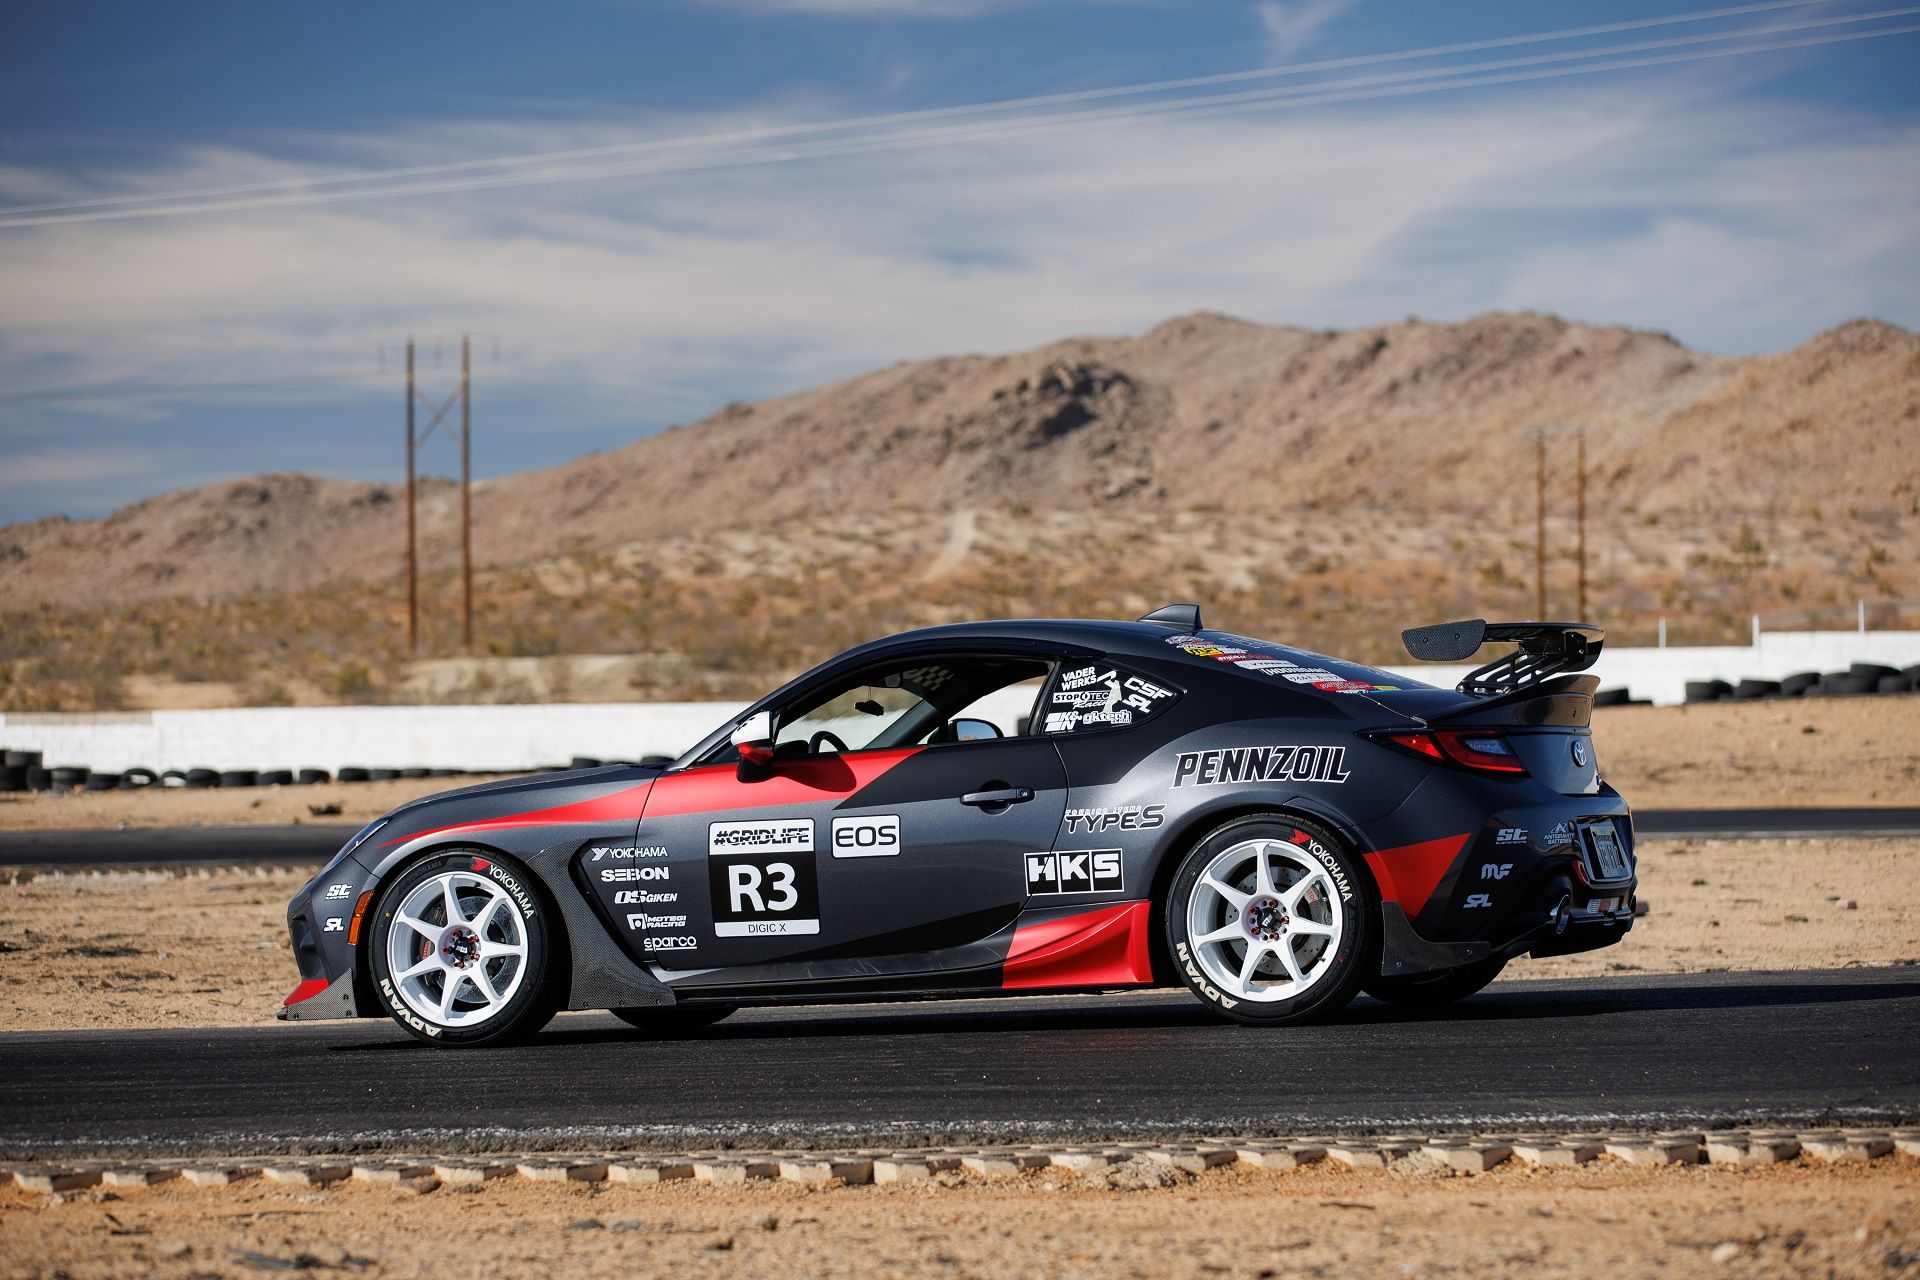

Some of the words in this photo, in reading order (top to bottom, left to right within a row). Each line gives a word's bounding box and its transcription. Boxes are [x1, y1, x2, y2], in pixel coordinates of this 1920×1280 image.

[1062, 666, 1096, 682] VADER
[1061, 675, 1097, 691] WERKS
[1124, 677, 1173, 699] CSF
[1055, 692, 1110, 702] STOPTEC
[1170, 745, 1352, 789] PENNZOIL
[713, 827, 810, 846] #GRIDLIFE
[835, 825, 897, 847] EOS
[608, 846, 668, 859] YOKOHAMA
[600, 866, 670, 882] SEBON
[1028, 852, 1121, 883] HKS
[1307, 838, 1354, 902] YOKOHAMA
[488, 864, 535, 920] YOKOHAMA
[728, 862, 799, 913] R3
[645, 893, 678, 903] GIKEN
[647, 915, 687, 923] MOTEGI
[647, 920, 686, 928] RACING
[748, 923, 777, 933] DIGIC
[779, 923, 787, 932] X
[643, 936, 697, 952] sparco
[1176, 942, 1239, 1010] ADVAN
[380, 978, 442, 1037] ADVAN
